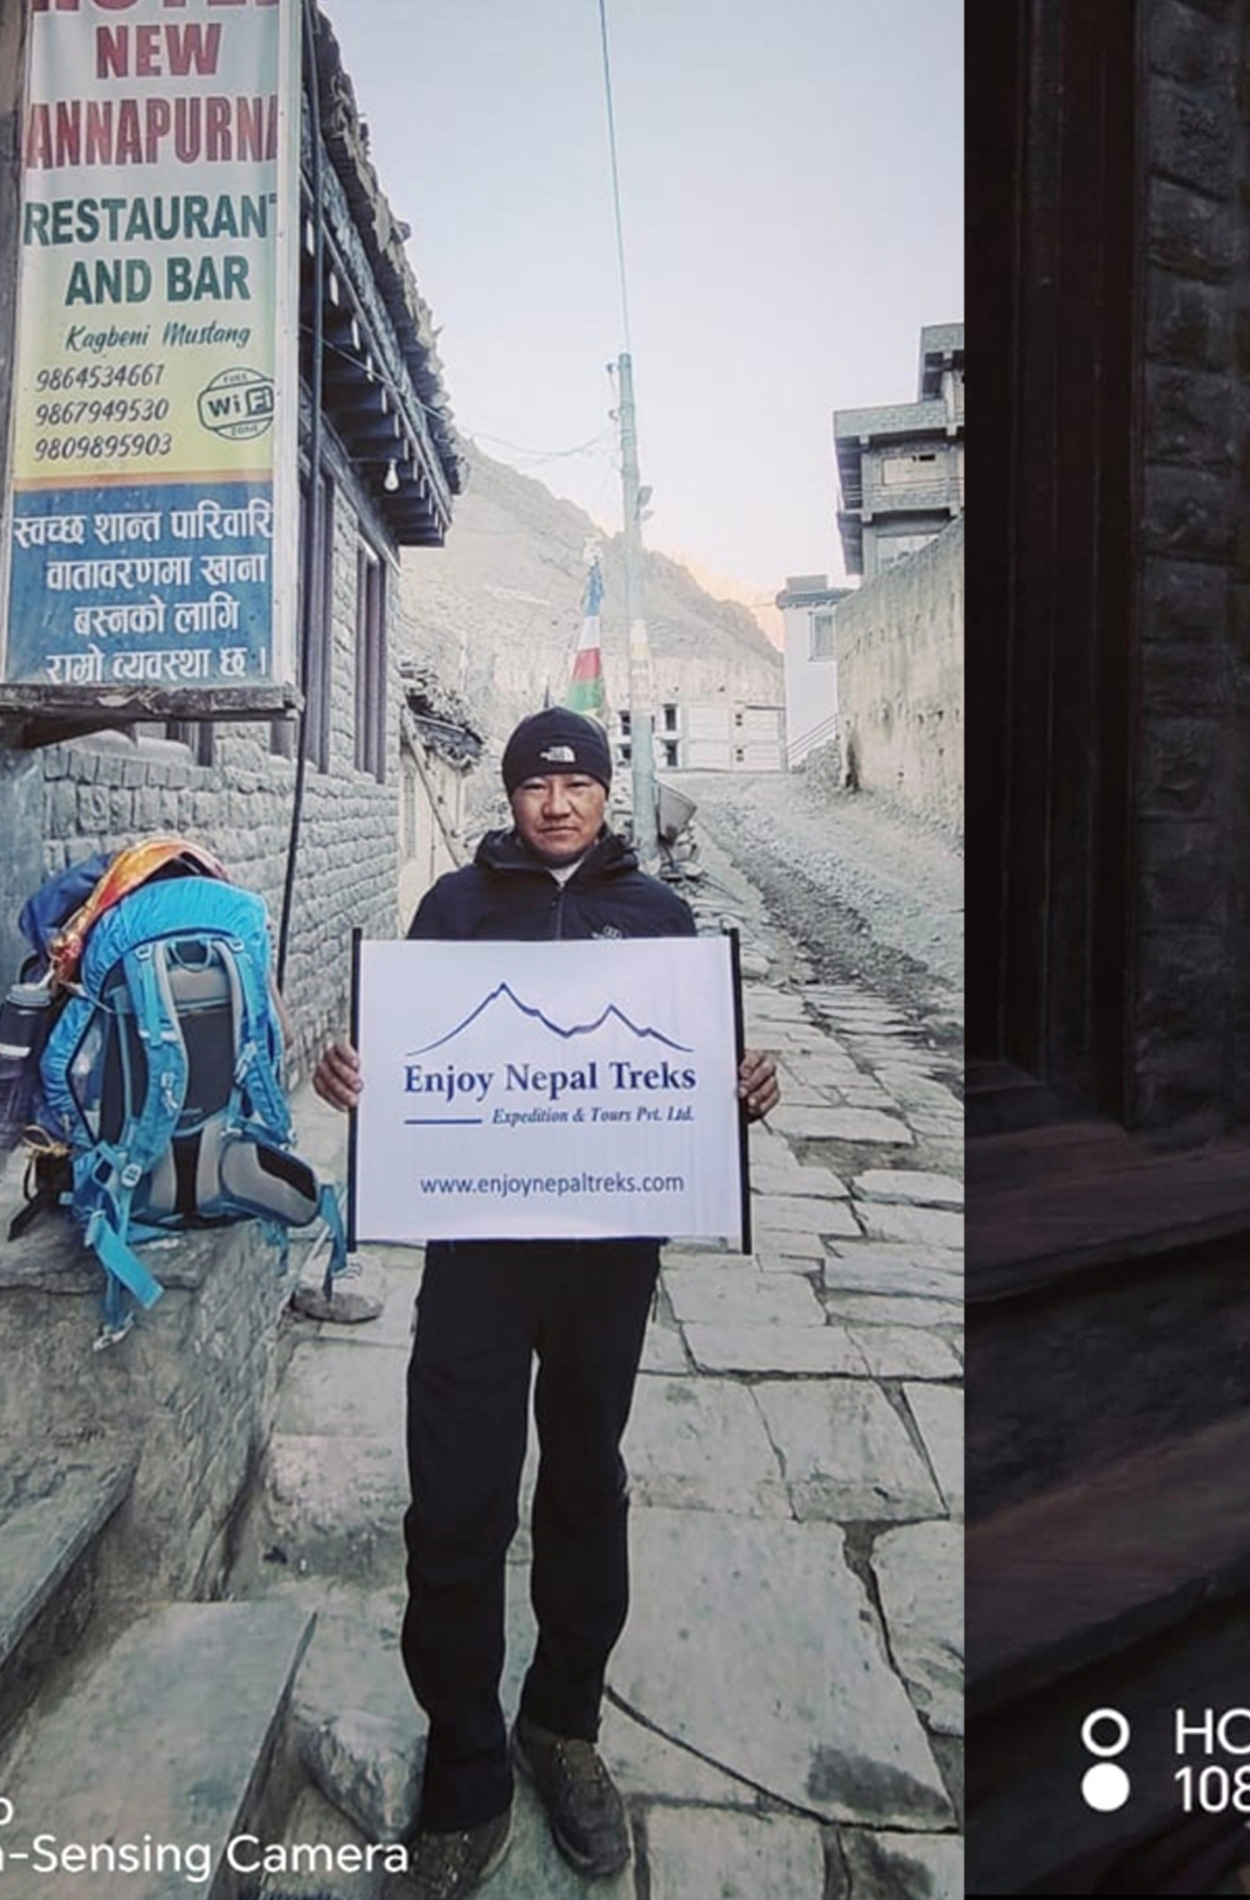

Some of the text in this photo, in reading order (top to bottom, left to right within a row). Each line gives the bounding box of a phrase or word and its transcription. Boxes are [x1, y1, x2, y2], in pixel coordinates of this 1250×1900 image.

[96, 23, 222, 79] NEW
[23, 193, 277, 246] RESTAURAN
[65, 255, 251, 306] AND BAR
[65, 321, 251, 354] Kagbeni Mustang
[36, 364, 164, 392] 9864534661
[36, 399, 169, 426] 9867949530
[34, 433, 173, 461] 9809895903
[14, 513, 87, 548] स्वच्छ
[95, 510, 162, 545] शान्त
[46, 553, 267, 591] वातावरणमा खाना
[74, 591, 240, 637] बस्नको लागि
[112, 648, 210, 681] व्यवस्था
[219, 647, 248, 677] छ
[404, 1062, 697, 1102] Enjoy Nepal Treks
[492, 1106, 695, 1128] Expedition & Tours Pvt. Ltd.
[420, 1171, 684, 1197] www.enjoynepaltreks.com
